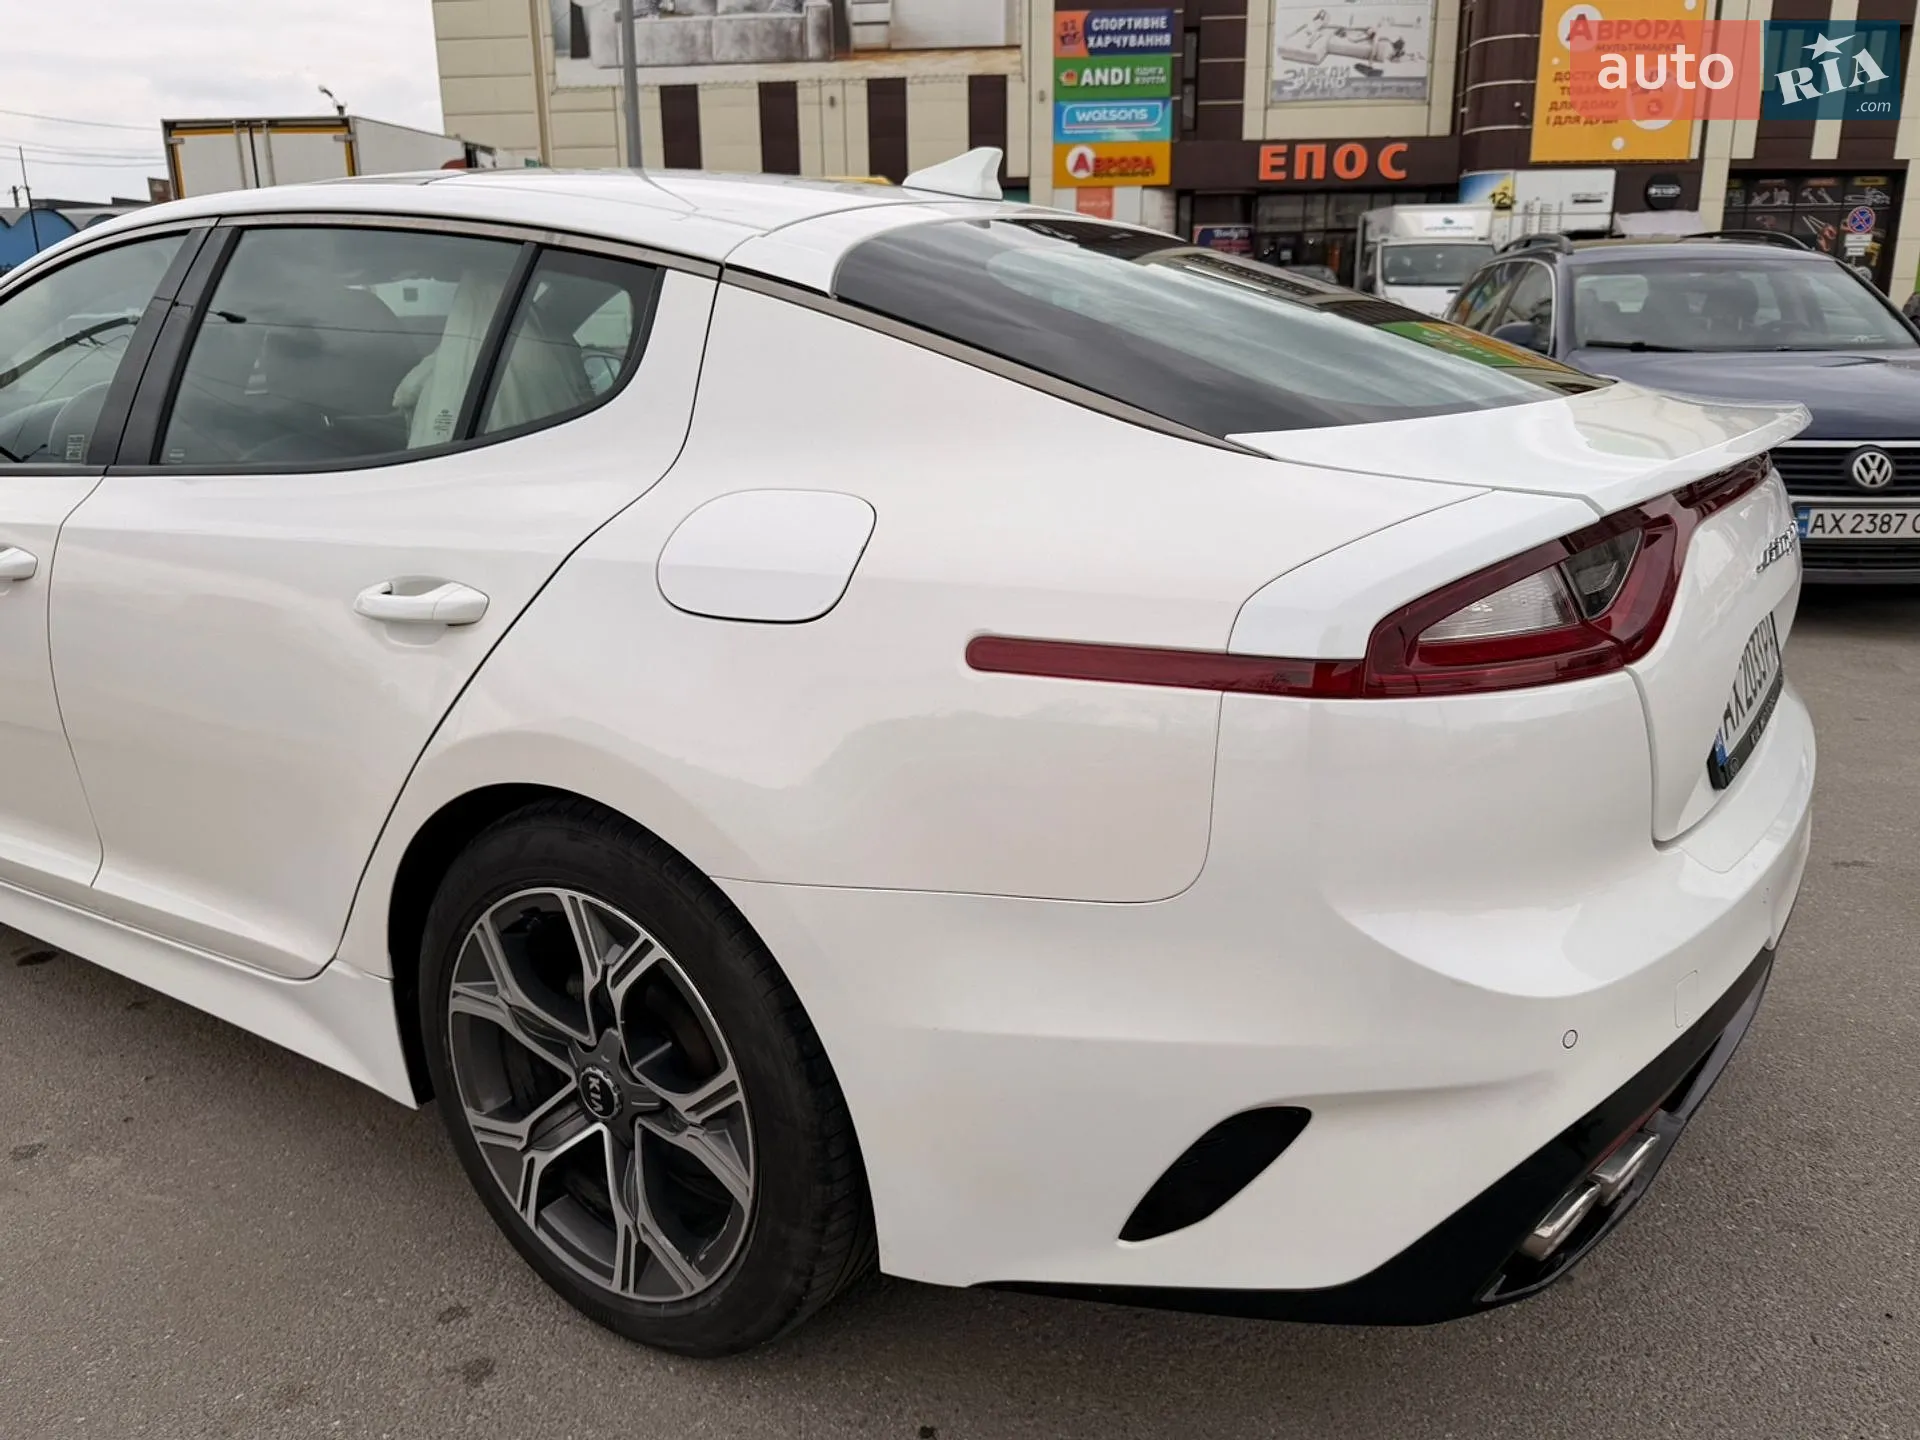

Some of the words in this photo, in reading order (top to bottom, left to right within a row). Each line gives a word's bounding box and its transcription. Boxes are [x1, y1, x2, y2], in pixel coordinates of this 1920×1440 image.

[1091, 16, 1168, 31] СПОРТИВНЕ
[1087, 34, 1171, 48] ХАРЧУВАННЯ
[1081, 67, 1132, 86] ANDI
[1076, 108, 1149, 122] watsons
[1258, 143, 1409, 181] ЕПОС
[1810, 513, 1846, 534] AX
[1849, 513, 1907, 534] 2387
